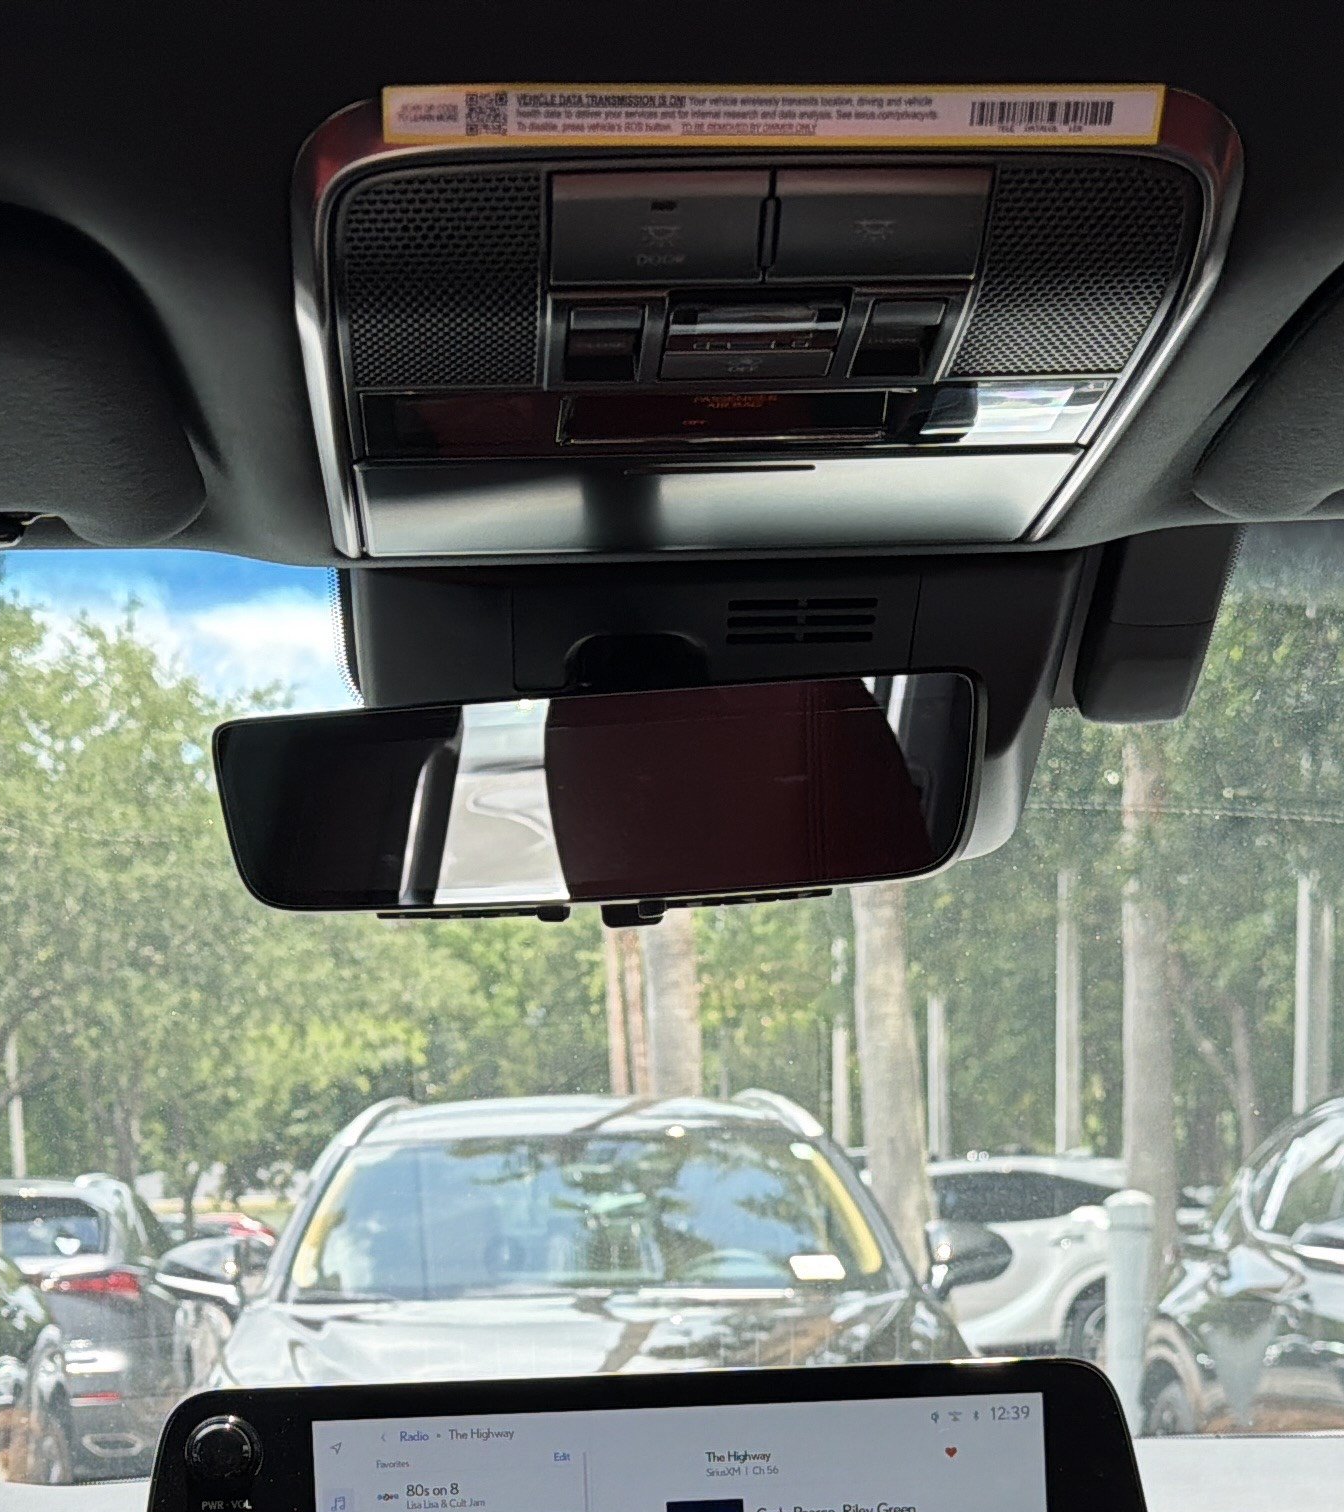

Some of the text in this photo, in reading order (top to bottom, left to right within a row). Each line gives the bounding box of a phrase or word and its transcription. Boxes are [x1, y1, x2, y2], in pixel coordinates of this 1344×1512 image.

[990, 1406, 1030, 1421] 12:39
[400, 1428, 515, 1442] Radio The Highway
[376, 1452, 570, 1469] Favorites Edit
[706, 1450, 771, 1463] The Highway
[706, 1465, 779, 1477] SiriusXM Ch 56
[406, 1484, 430, 1497] 80s
[433, 1486, 447, 1496] on
[450, 1483, 459, 1495] 8
[202, 1499, 252, 1511] PWR VOL
